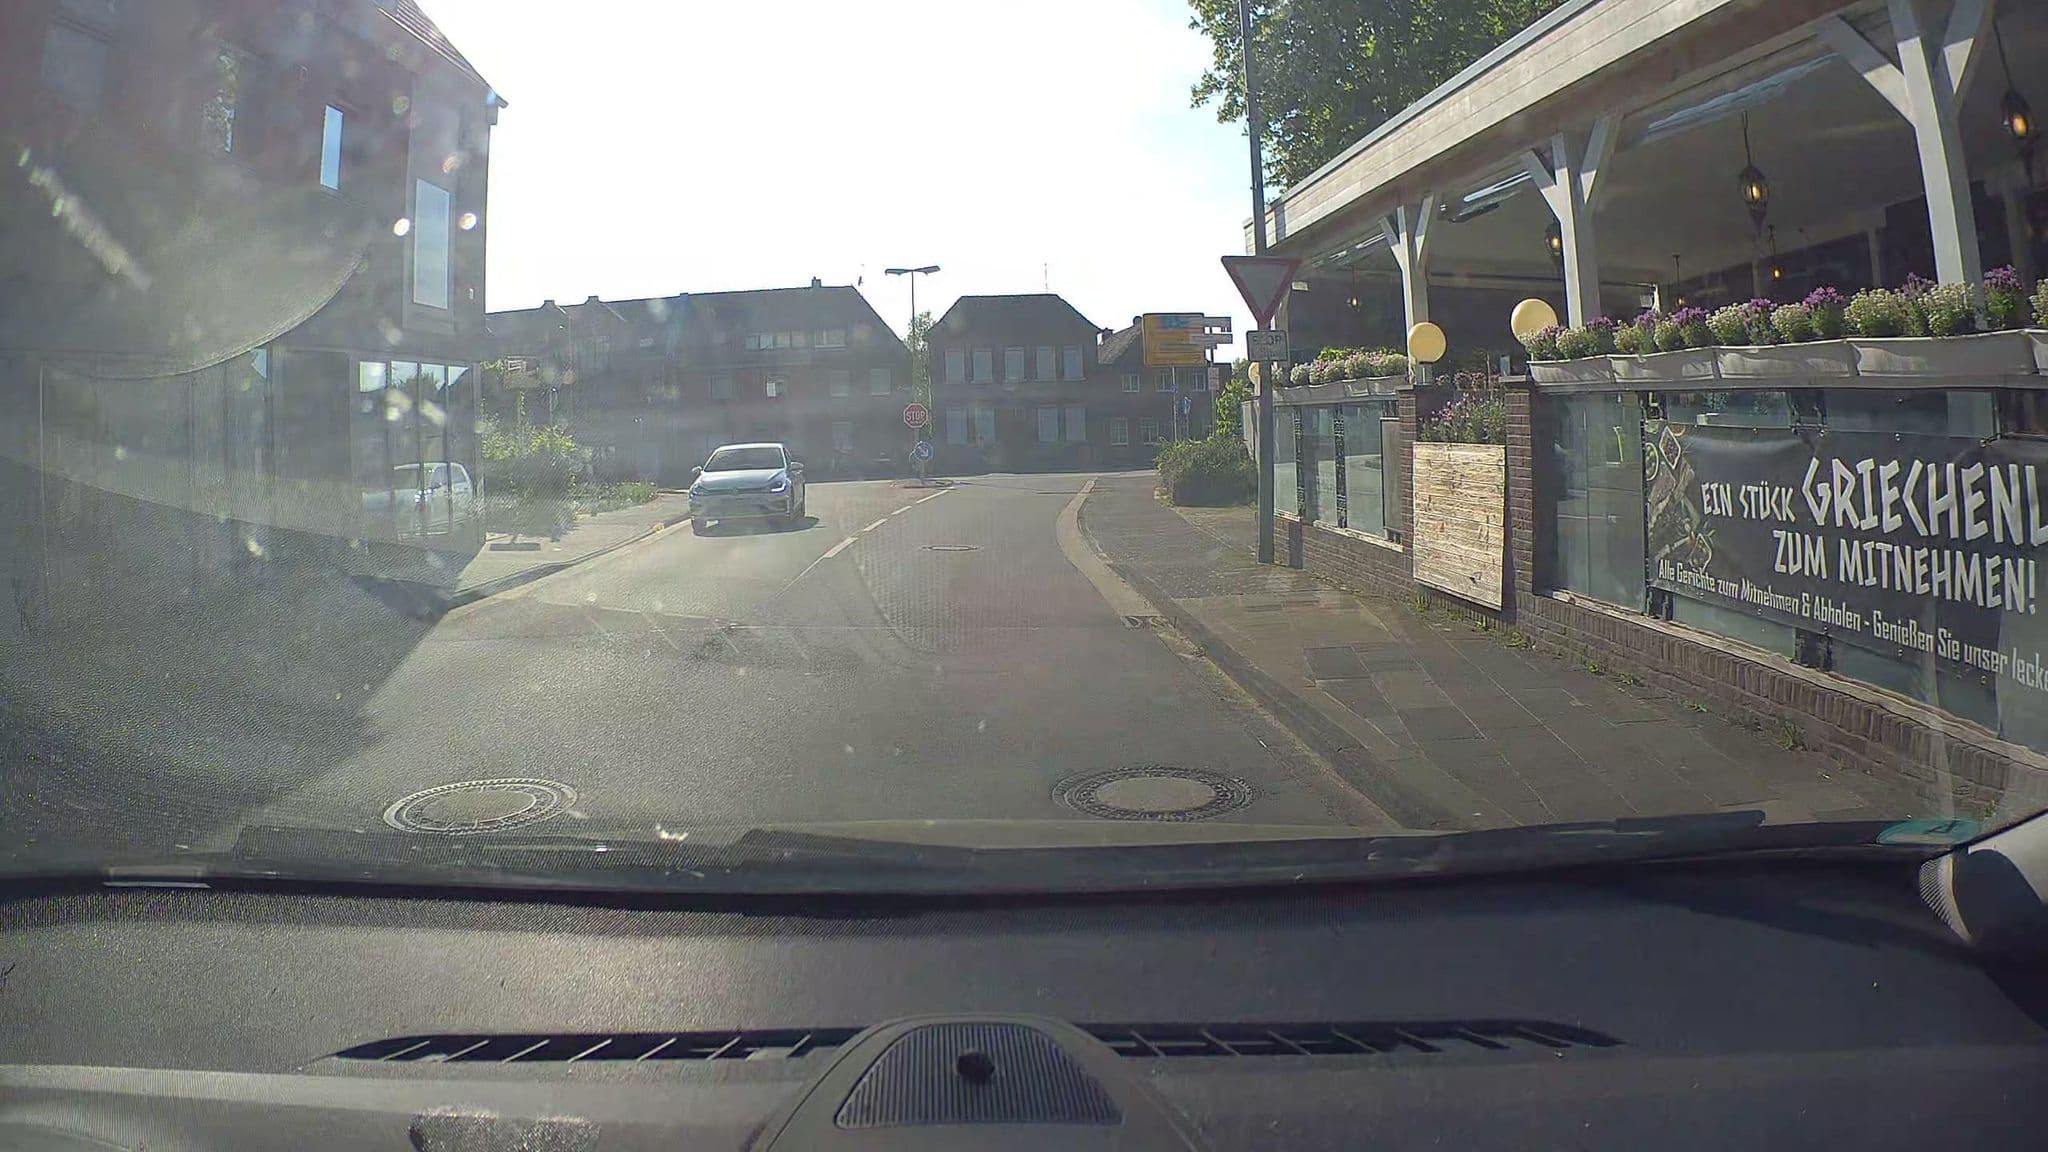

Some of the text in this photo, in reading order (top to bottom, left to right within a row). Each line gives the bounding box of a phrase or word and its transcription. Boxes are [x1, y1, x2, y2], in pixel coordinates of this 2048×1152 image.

[1252, 334, 1283, 346] SOP
[906, 409, 926, 421] STOP
[1701, 456, 2048, 547] EIN STÜCK GRIECHENL
[1773, 530, 2036, 614] ZUM MITNEHMEN!
[1658, 558, 1675, 582] Alle
[1676, 562, 1716, 593] Gerichte
[1717, 579, 1738, 599] zum
[1741, 577, 1799, 615] Mitnehmen
[1802, 592, 1812, 617] &
[1813, 594, 1861, 632] Abholen
[1872, 609, 1935, 653] Genießen
[1937, 627, 1961, 662] Sie
[1963, 643, 2008, 674] unser
